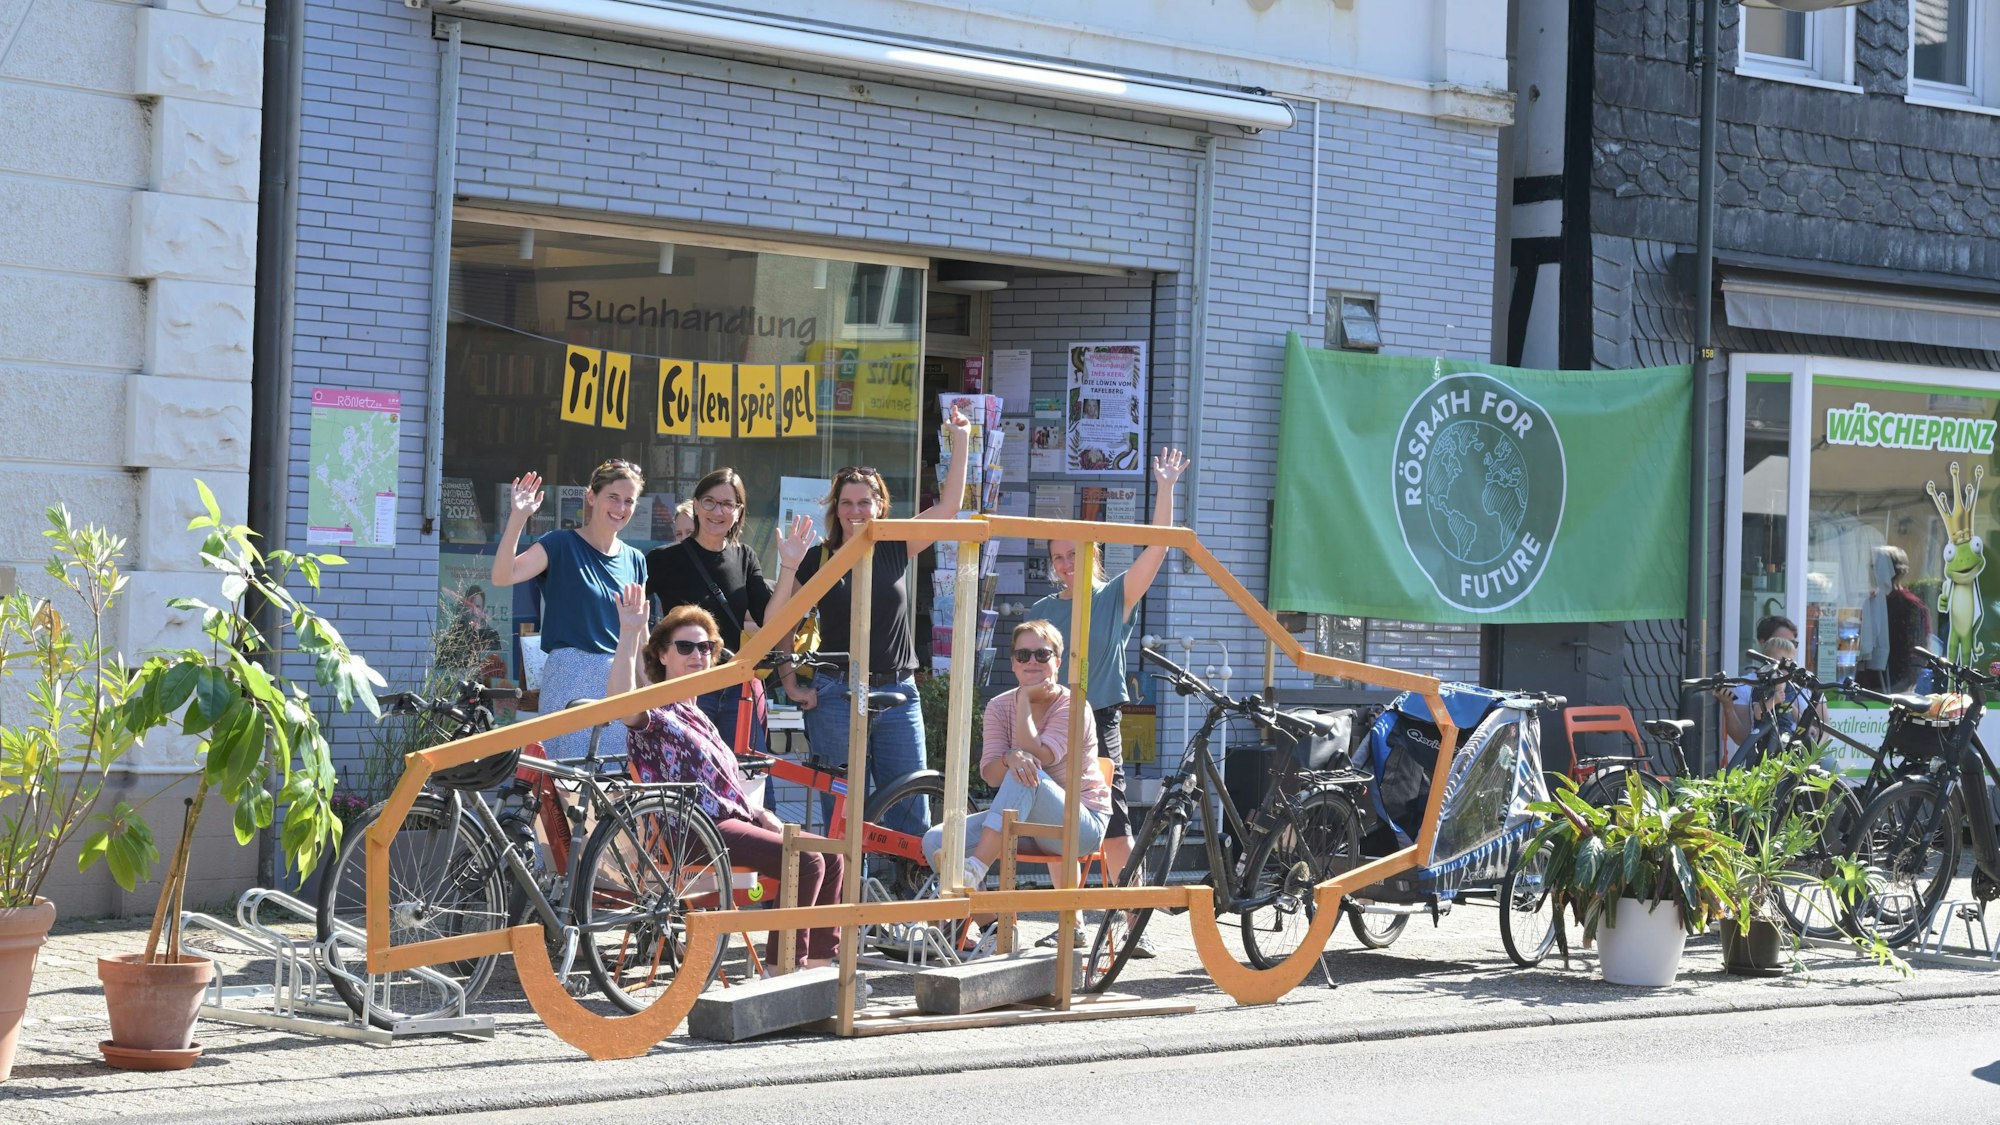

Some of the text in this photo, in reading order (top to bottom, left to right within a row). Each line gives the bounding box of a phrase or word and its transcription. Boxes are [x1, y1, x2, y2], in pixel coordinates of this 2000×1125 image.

[567, 290, 816, 346] Buchhandlung
[1701, 348, 1714, 359] 158
[568, 352, 814, 434] Till Eulenspiegel
[1096, 379, 1117, 387] LÖWIN
[1398, 389, 1533, 506] RÖSRATH FOR
[1828, 405, 1996, 452] WÄSCHEPRINZ
[443, 498, 475, 506] RECORDS
[445, 505, 478, 519] 2024
[1460, 531, 1542, 599] FUTURE
